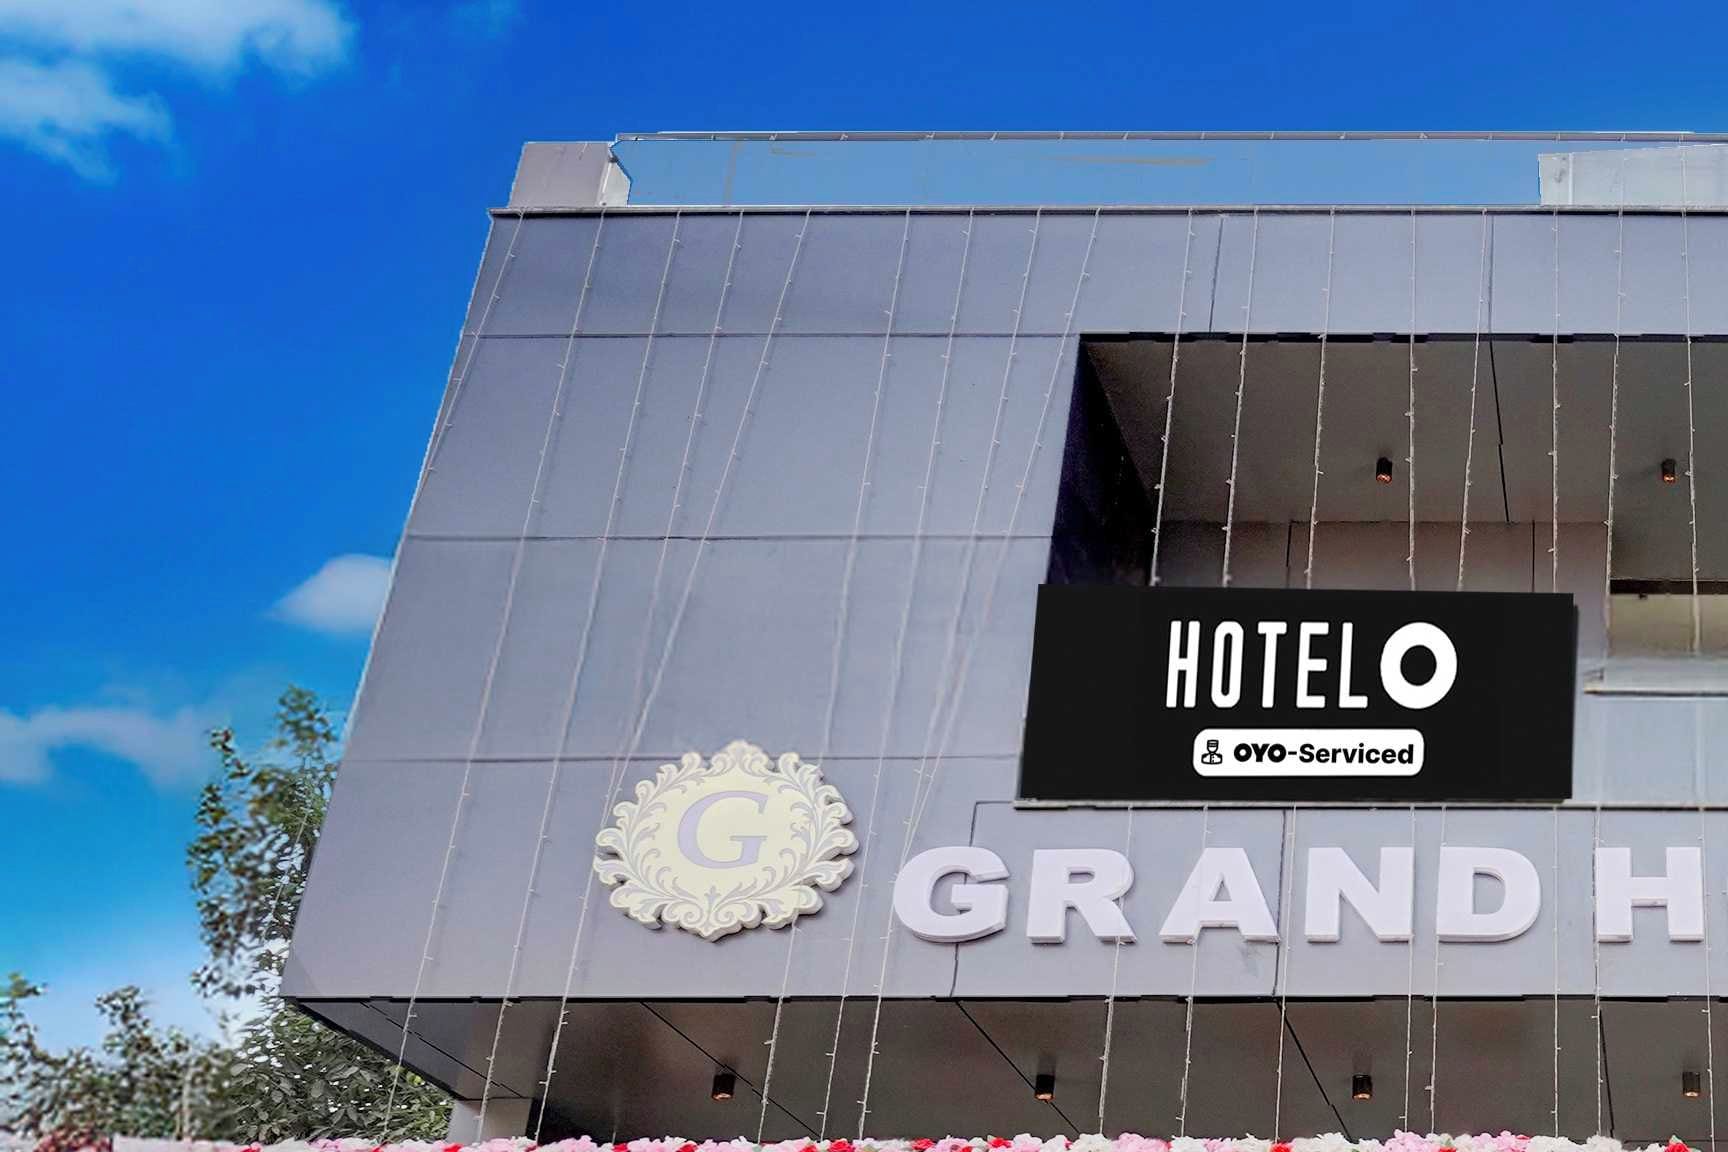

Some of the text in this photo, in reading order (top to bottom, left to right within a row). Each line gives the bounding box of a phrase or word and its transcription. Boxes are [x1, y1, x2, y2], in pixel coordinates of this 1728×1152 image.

[1233, 742, 1414, 765] OYO-Serviced
[677, 789, 770, 870] G
[893, 845, 1541, 943] GRAND
